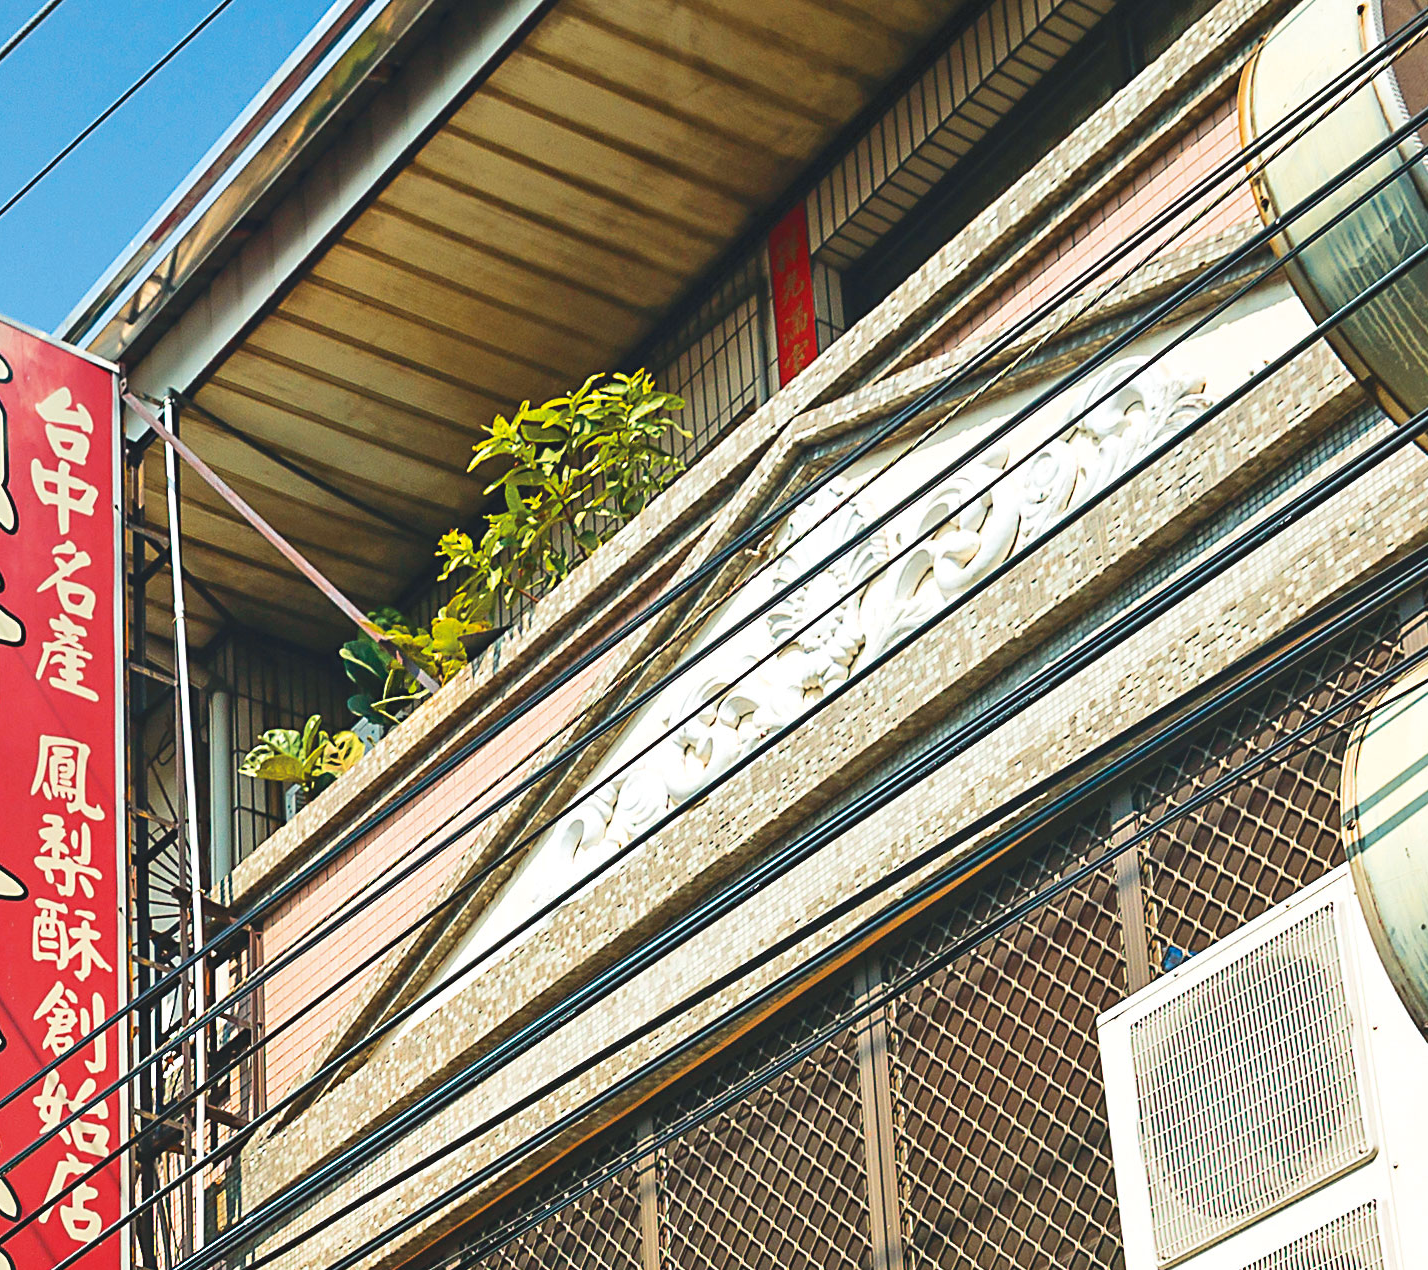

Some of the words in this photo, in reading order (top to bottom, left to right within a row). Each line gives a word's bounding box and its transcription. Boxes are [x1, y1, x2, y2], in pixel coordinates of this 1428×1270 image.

[30, 386, 99, 702] 台中名產
[30, 733, 113, 1247] 鳳梨酥創始店
